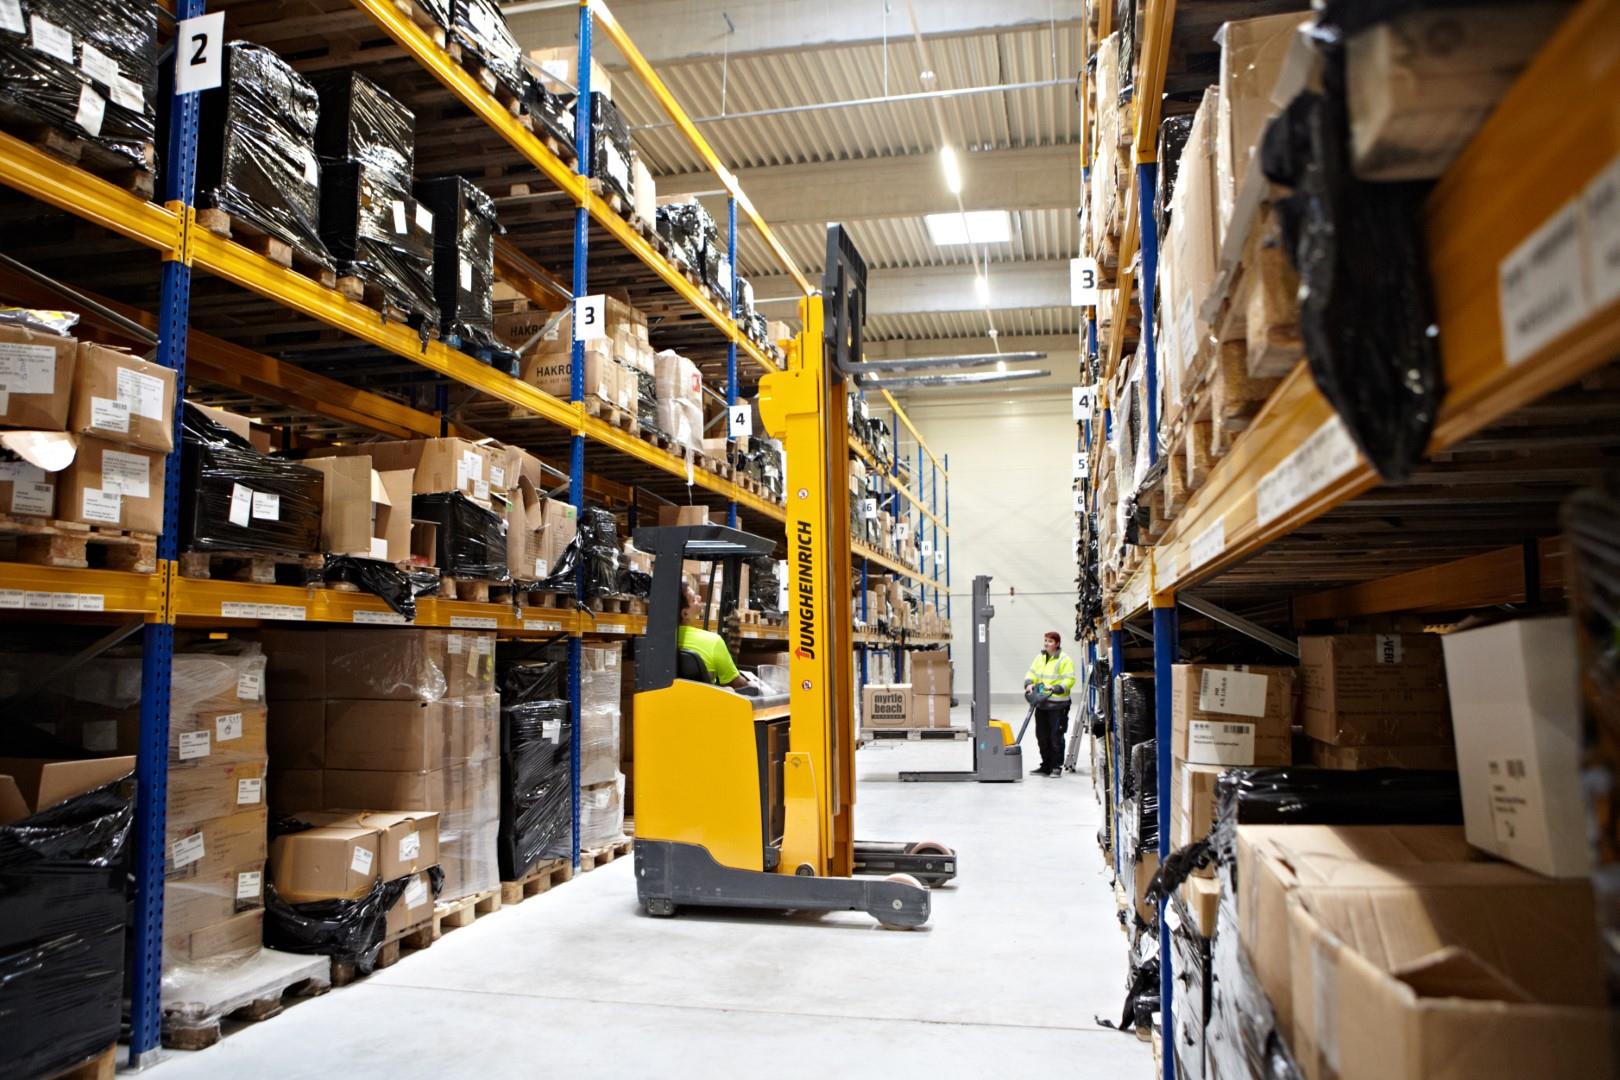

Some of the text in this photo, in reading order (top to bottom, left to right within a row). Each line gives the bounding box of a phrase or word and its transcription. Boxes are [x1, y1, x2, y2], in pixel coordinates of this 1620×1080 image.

[190, 32, 207, 66] 2
[1082, 269, 1095, 289] 3
[584, 306, 595, 325] 3
[510, 324, 543, 336] HAKR
[536, 363, 572, 377] HAKRO
[1079, 394, 1089, 408] 4
[735, 412, 746, 425] 4
[1078, 459, 1085, 469] 5
[1077, 496, 1083, 505] 6
[866, 503, 873, 512] 6
[899, 526, 905, 534] 7
[797, 520, 815, 660] JUNGHEINRICH
[874, 693, 903, 704] myrtle
[874, 703, 903, 714] beach
